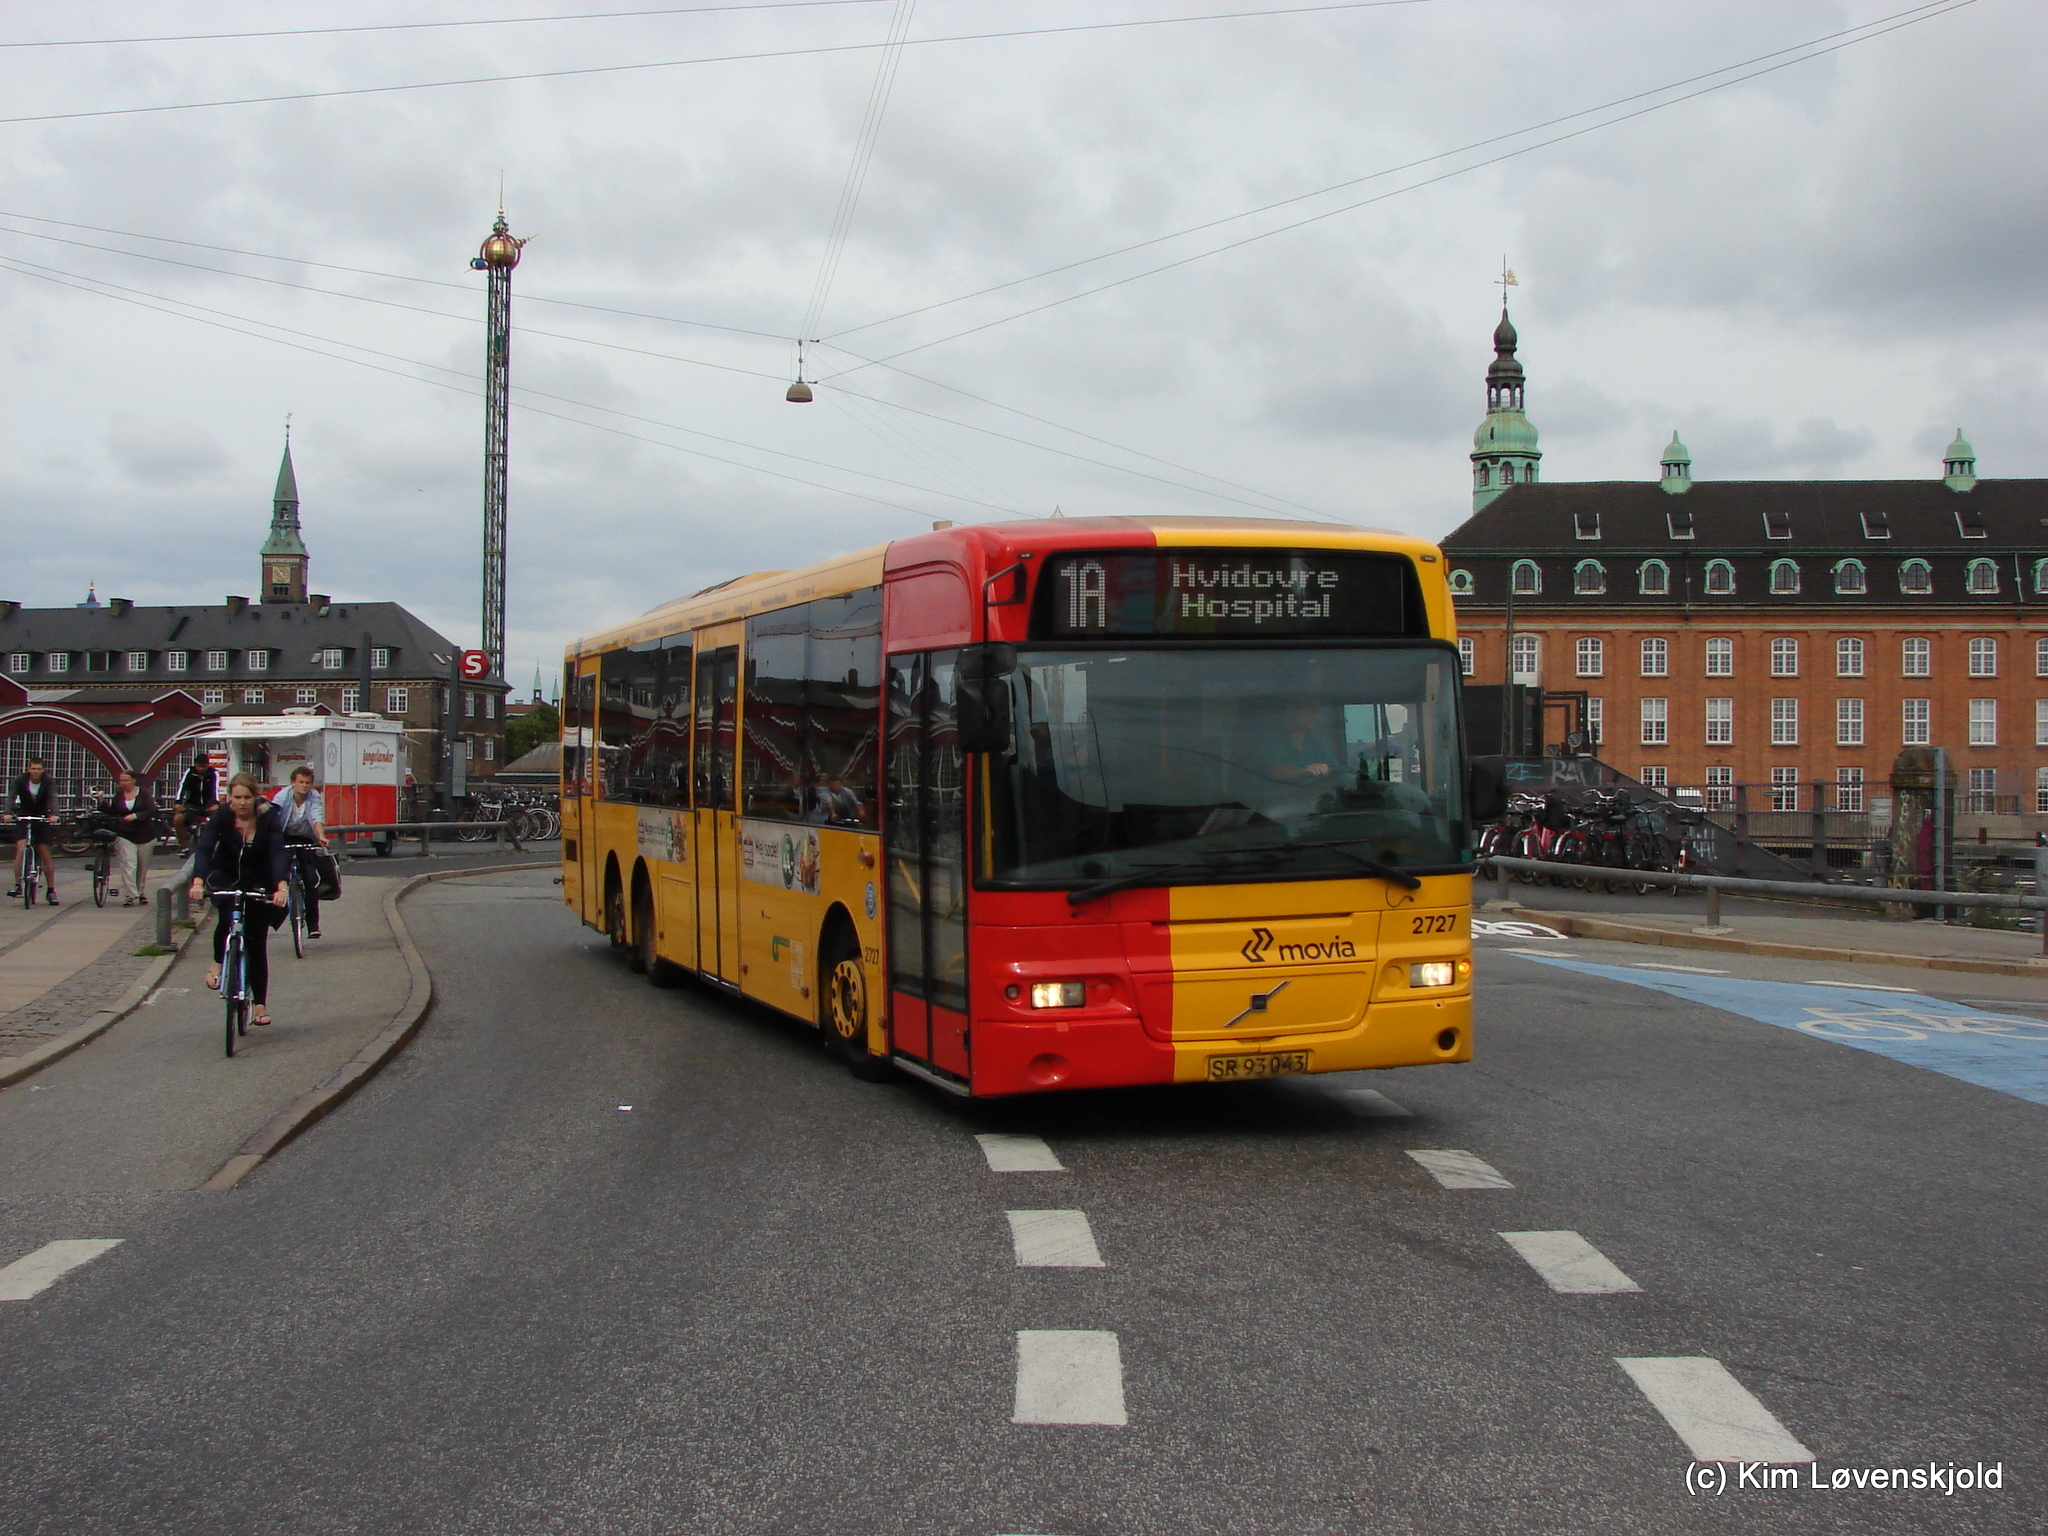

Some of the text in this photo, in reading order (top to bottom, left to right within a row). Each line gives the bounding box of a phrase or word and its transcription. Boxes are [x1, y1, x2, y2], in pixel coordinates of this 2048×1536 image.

[1172, 563, 1339, 588] Hvidovre
[1060, 560, 1106, 627] 1A
[1181, 593, 1330, 624] Hospital
[465, 655, 482, 674] S
[1411, 914, 1457, 935] 2727
[865, 946, 880, 965] 2727
[1278, 935, 1356, 961] movia
[1211, 1054, 1304, 1077] SR 93 043
